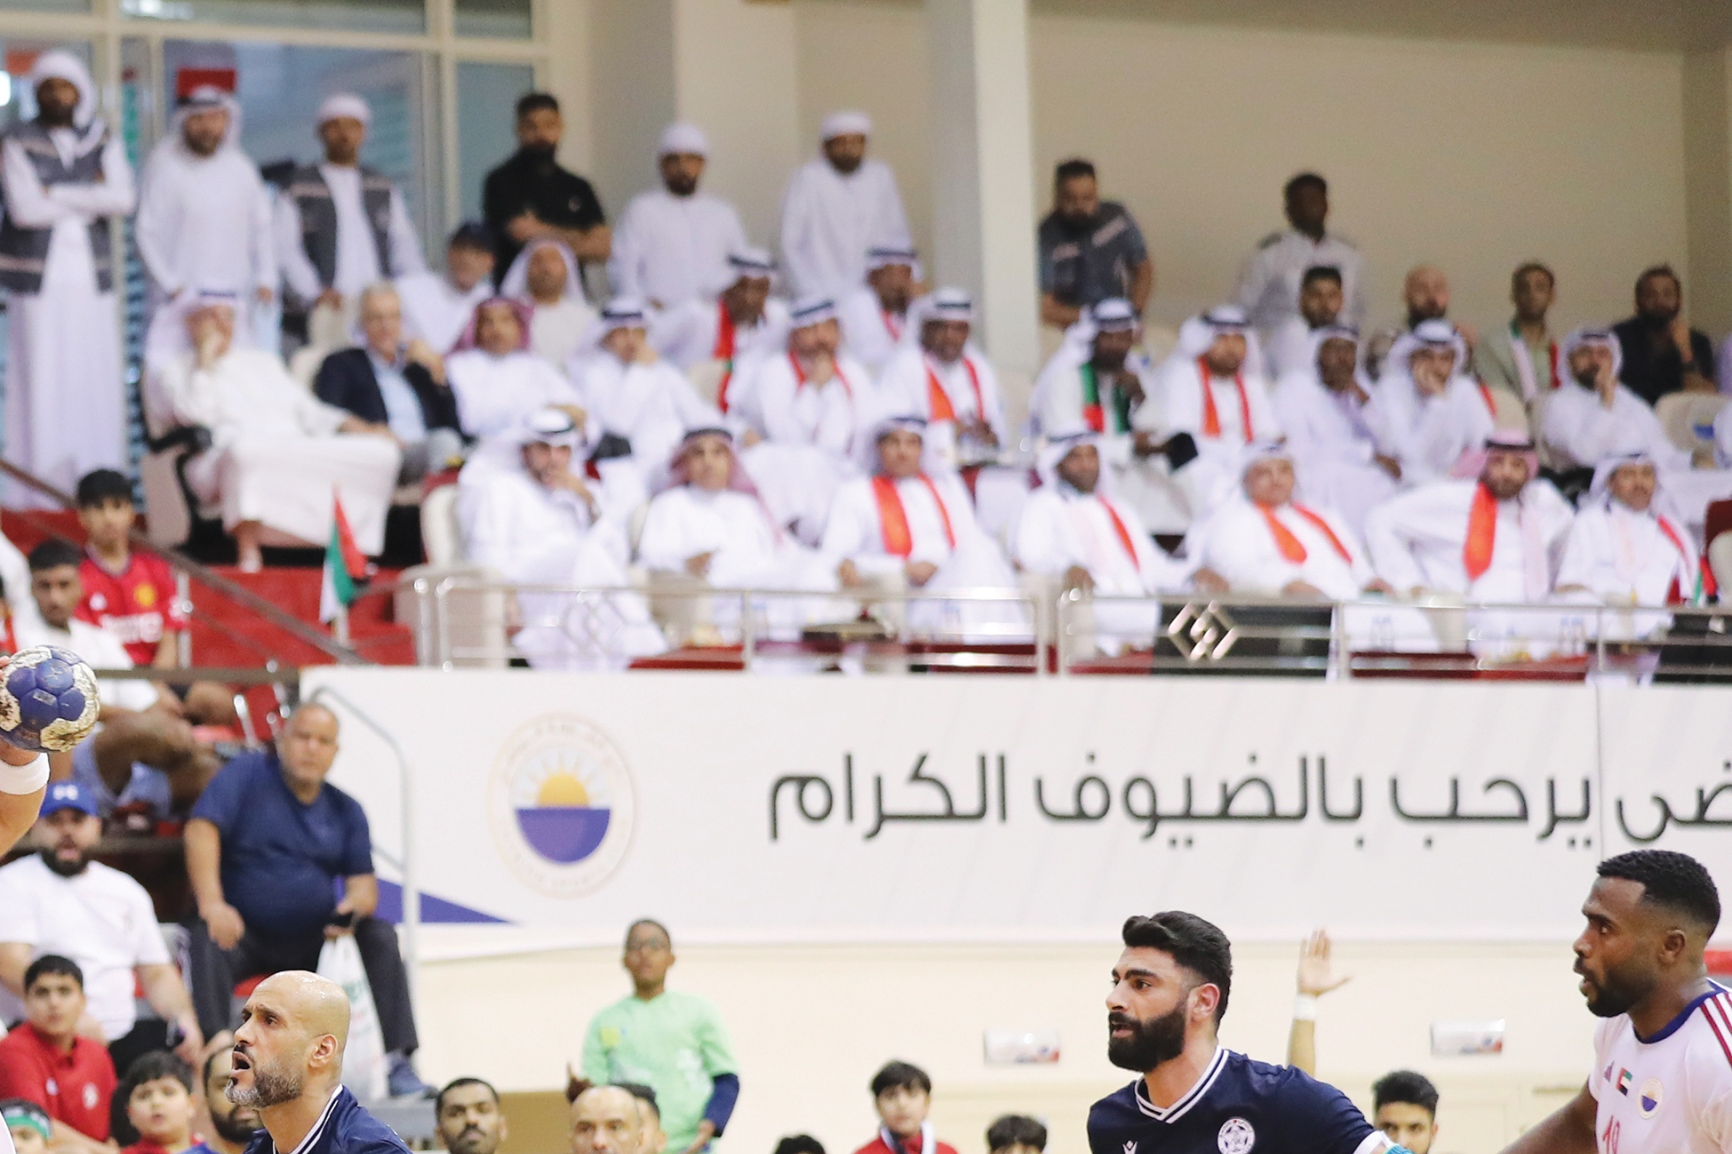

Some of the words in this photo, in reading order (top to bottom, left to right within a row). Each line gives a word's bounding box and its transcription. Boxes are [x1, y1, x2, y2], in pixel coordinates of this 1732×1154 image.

[770, 752, 1008, 841] الكرام
[1034, 752, 1363, 849] بالضيوف
[1390, 776, 1592, 848] يرحب
